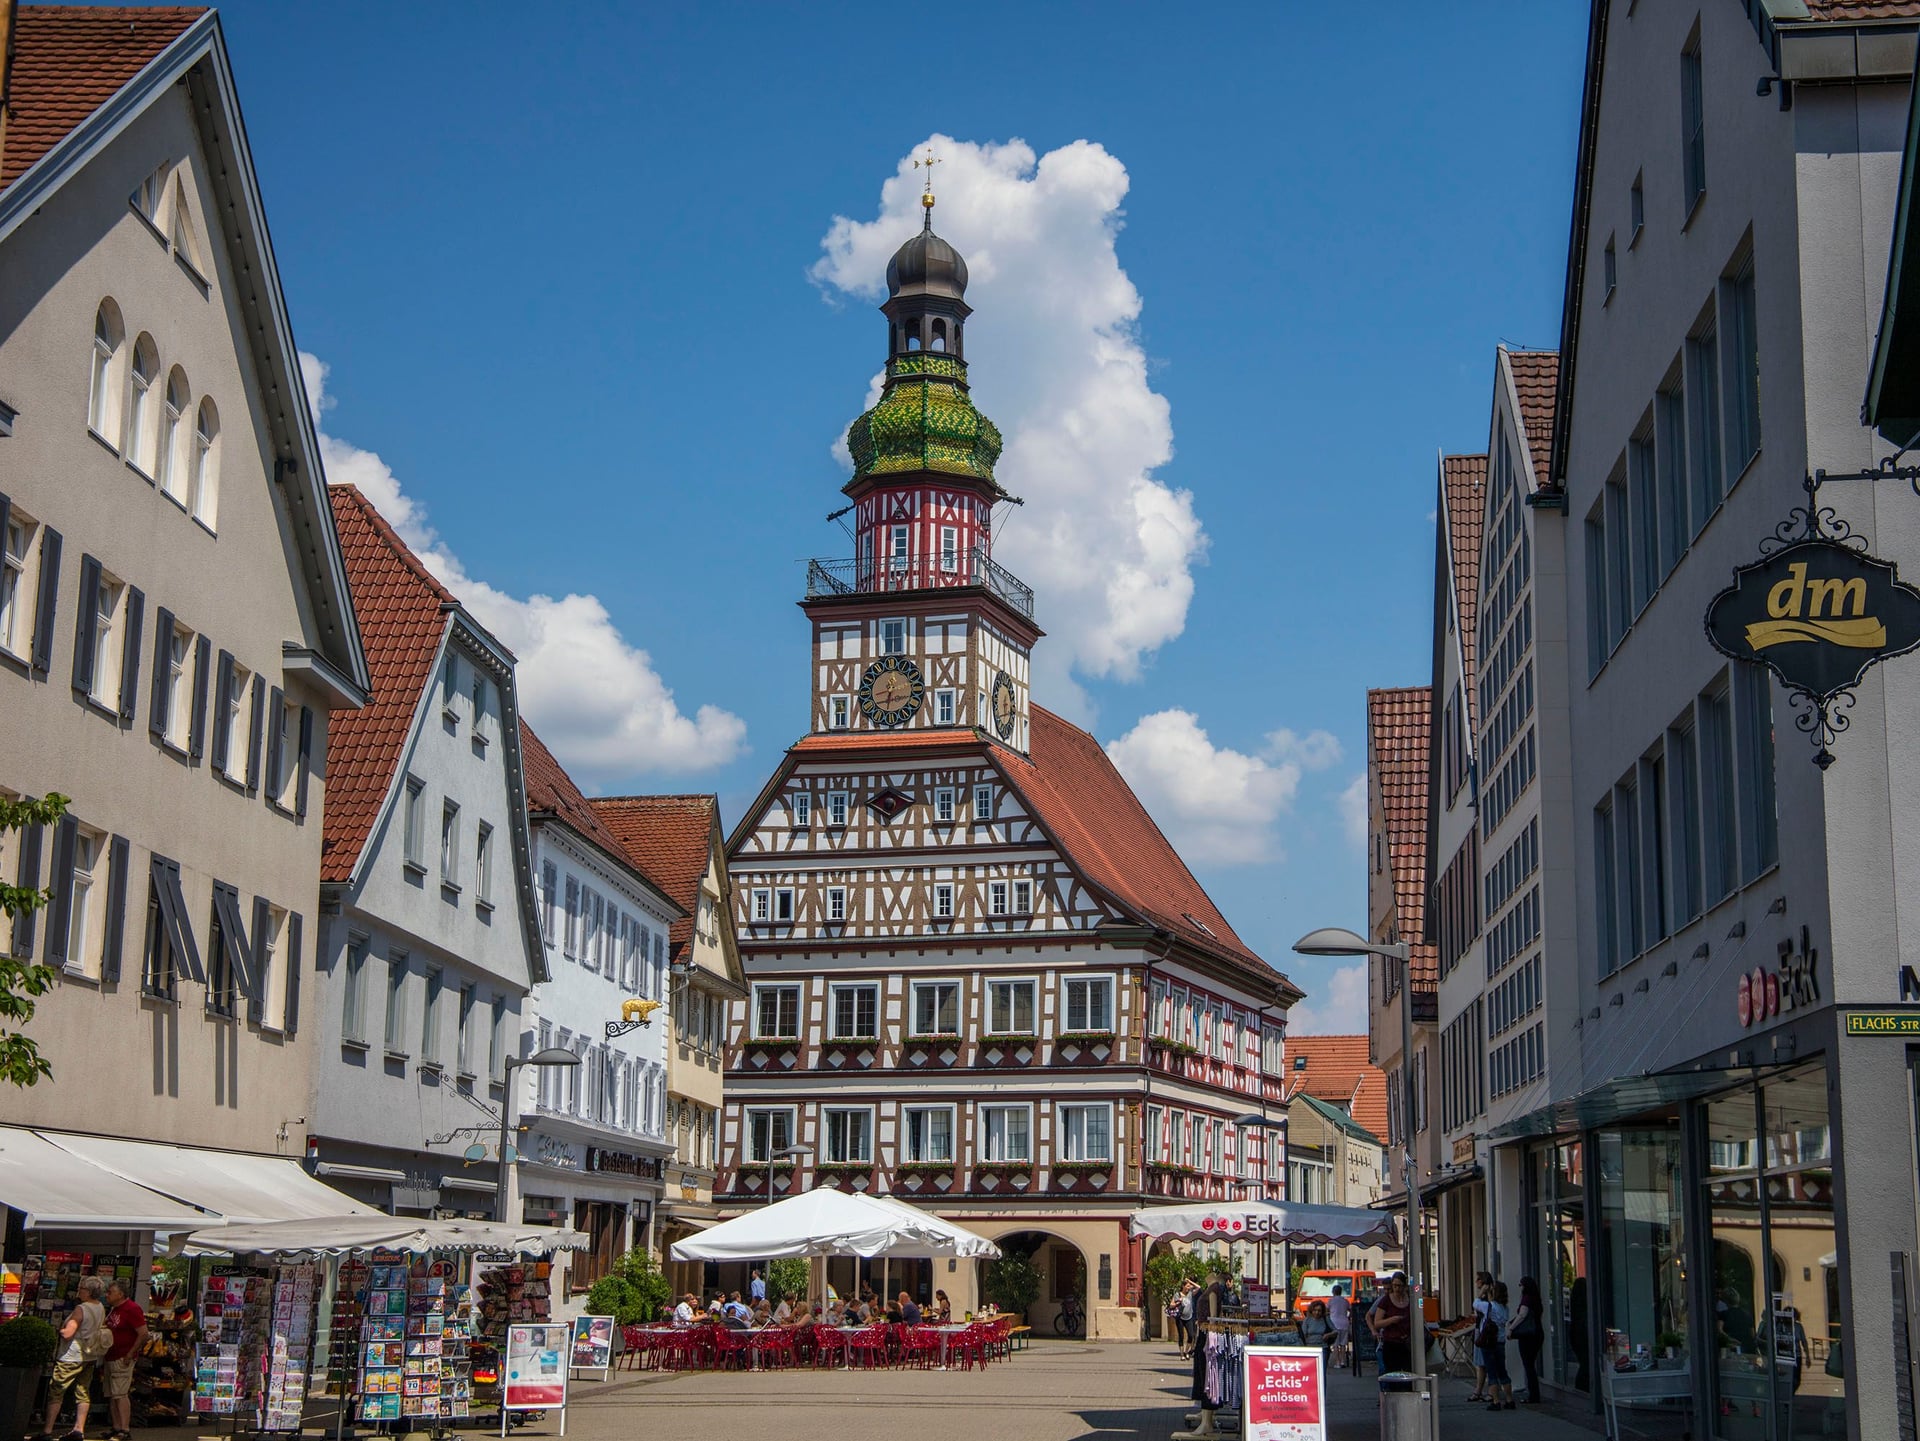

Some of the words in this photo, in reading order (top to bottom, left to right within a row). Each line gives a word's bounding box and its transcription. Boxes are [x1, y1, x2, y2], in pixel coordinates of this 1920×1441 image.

[1766, 562, 1867, 618] dm
[1777, 924, 1821, 1013] Eck
[1245, 1214, 1280, 1232] Eck
[434, 1263, 453, 1277] 3D
[1264, 1360, 1302, 1372] Jetzt
[1260, 1391, 1308, 1402] einlösen
[1280, 1431, 1295, 1439] 10%
